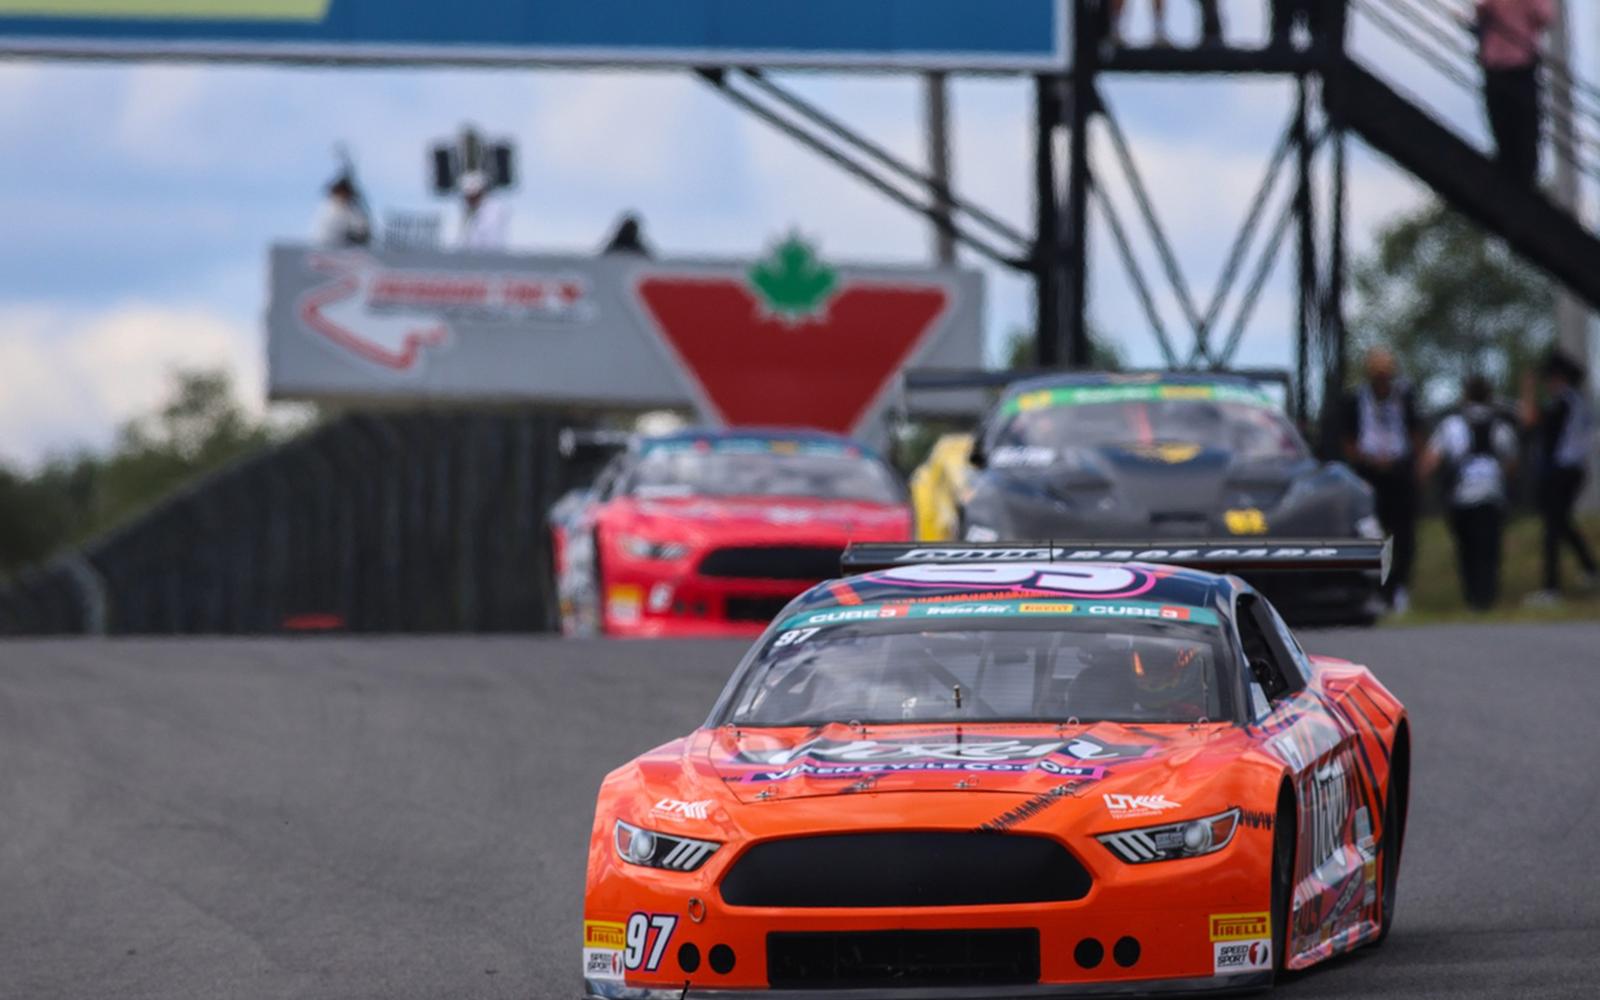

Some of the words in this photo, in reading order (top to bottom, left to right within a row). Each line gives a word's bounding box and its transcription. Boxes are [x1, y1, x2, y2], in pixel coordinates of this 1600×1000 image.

[774, 627, 822, 648] 97
[1212, 917, 1267, 936] PIRELLI
[623, 911, 679, 971] 97
[1220, 945, 1249, 955] SPEED
[1217, 955, 1246, 965] SPORT
